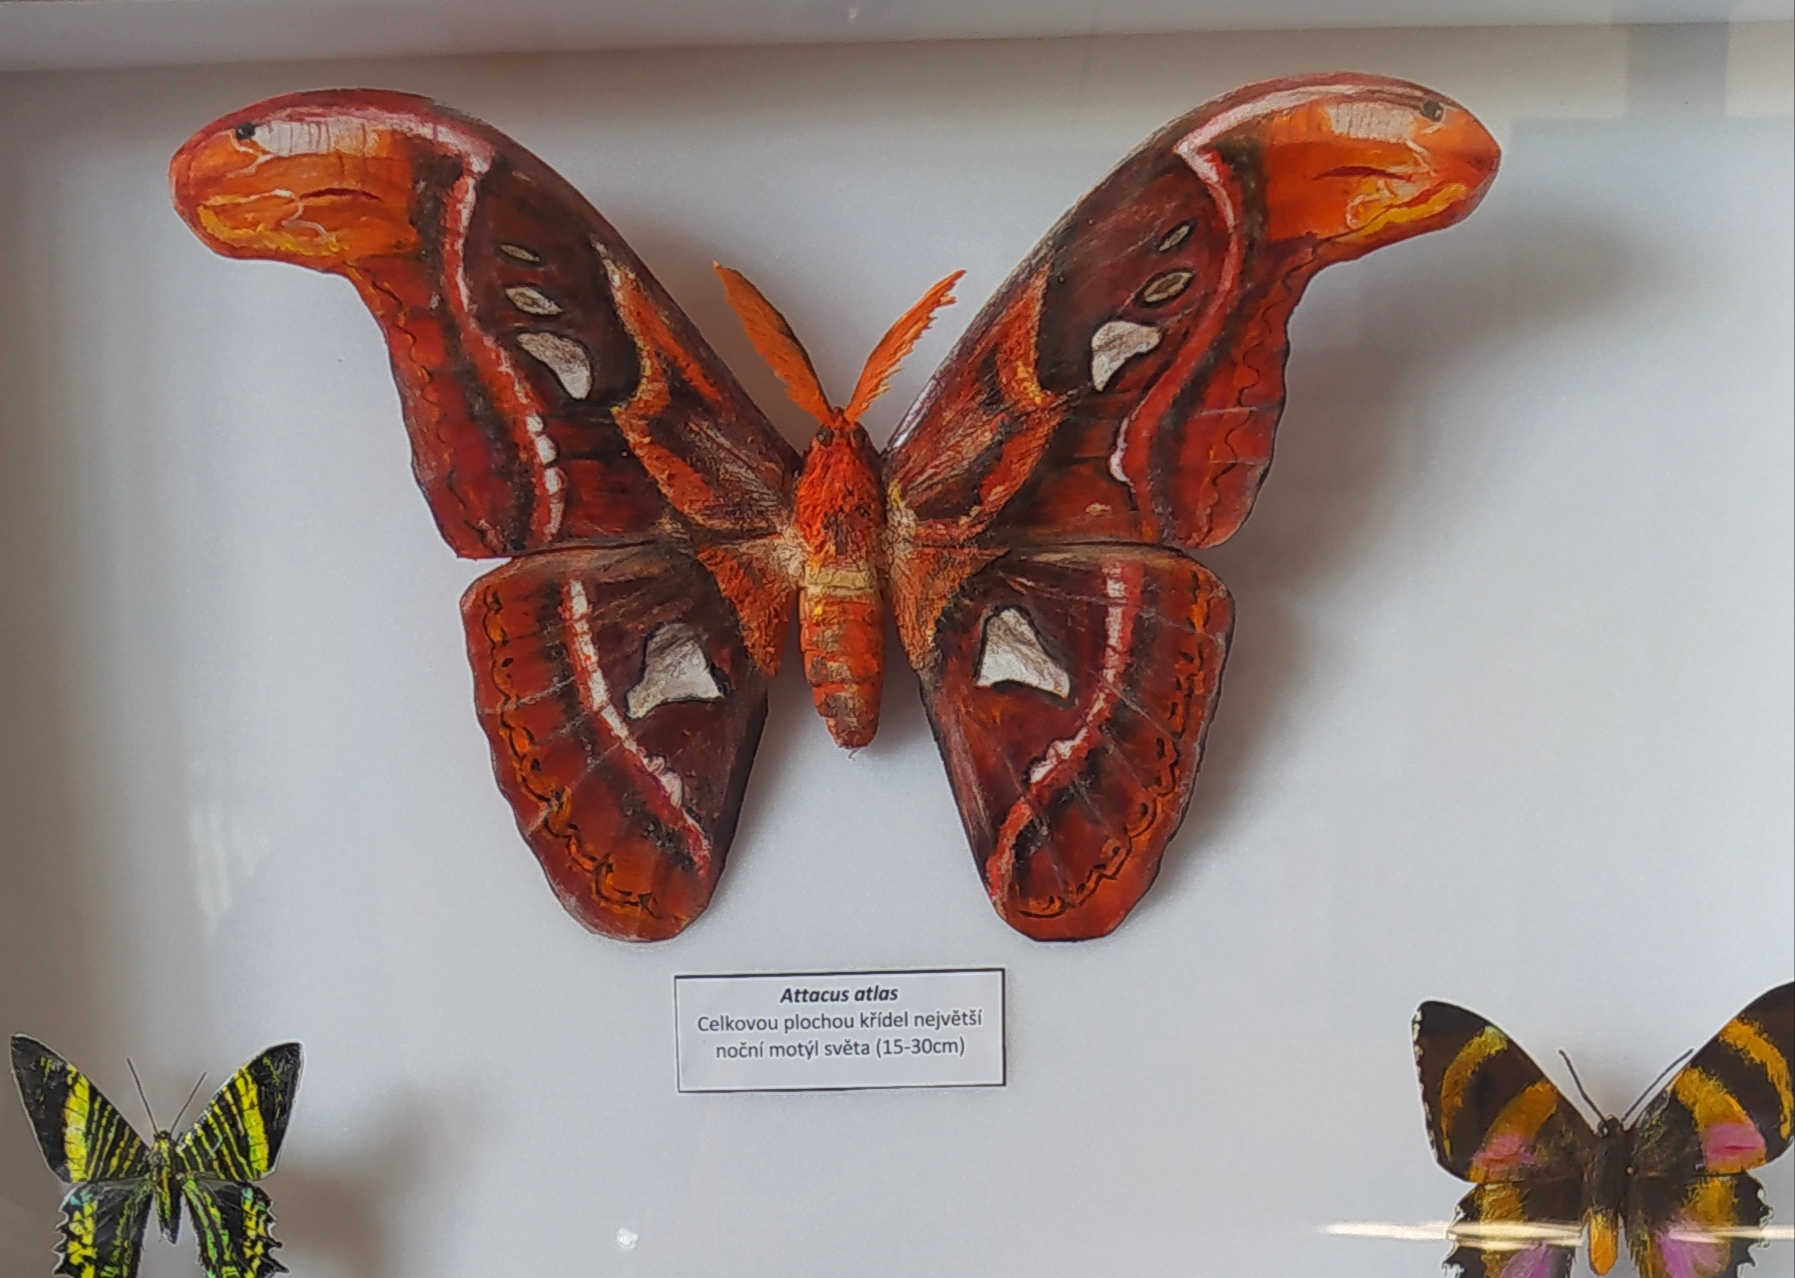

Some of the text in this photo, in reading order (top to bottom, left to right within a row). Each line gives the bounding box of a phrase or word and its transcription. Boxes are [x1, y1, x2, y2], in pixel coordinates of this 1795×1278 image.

[780, 986, 898, 1003] Attacus atlas
[698, 1010, 981, 1033] Celkovou plochou křídel největší
[717, 1037, 965, 1060] noční motýl světa (15-30cm)
